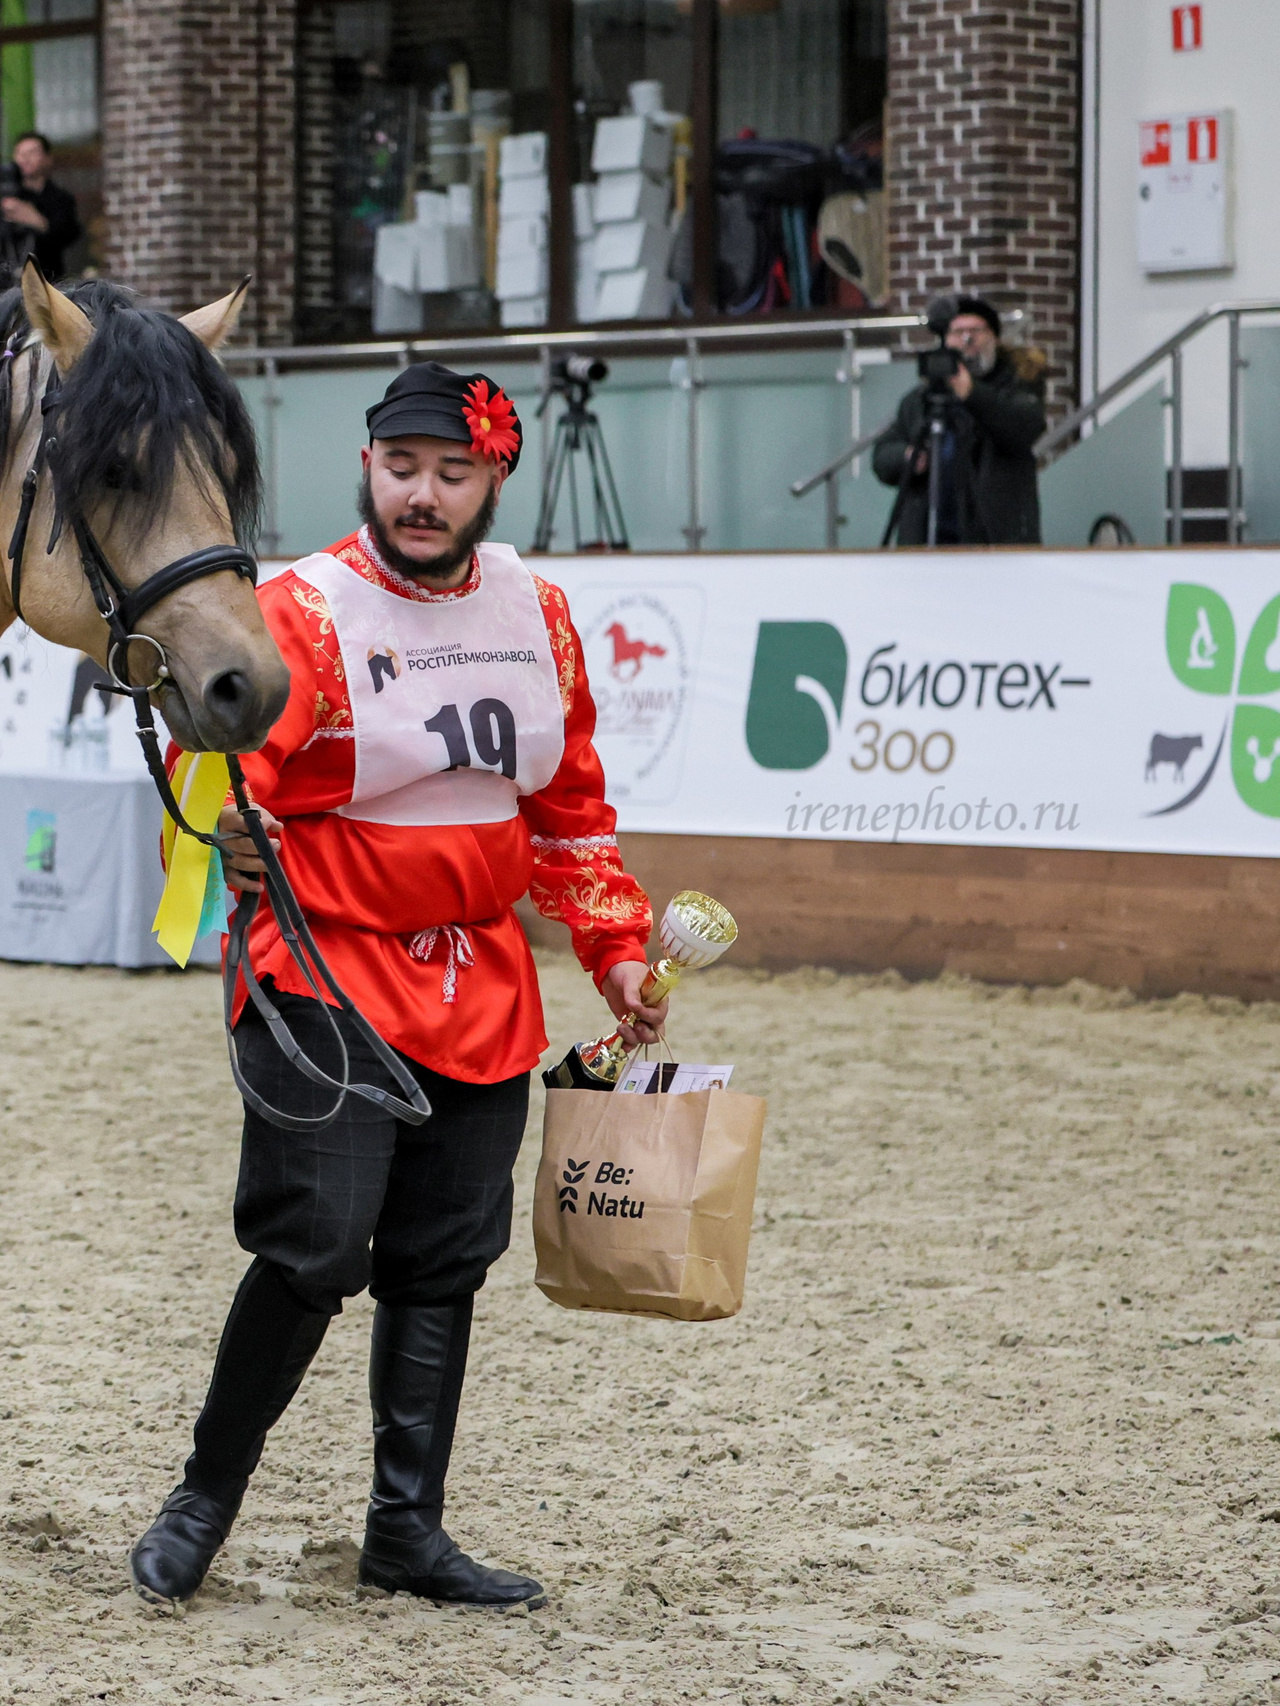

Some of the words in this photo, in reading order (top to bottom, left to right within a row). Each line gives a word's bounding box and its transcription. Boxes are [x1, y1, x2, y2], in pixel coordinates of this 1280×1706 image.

[406, 643, 462, 657] АССОЦИАЦИЯ
[407, 650, 537, 671] РОСПЛЕМКОНЗАВОД
[860, 642, 1091, 710] биотех-
[423, 697, 517, 781] 19
[594, 1161, 634, 1186] Be:
[587, 1191, 645, 1219] Natu
